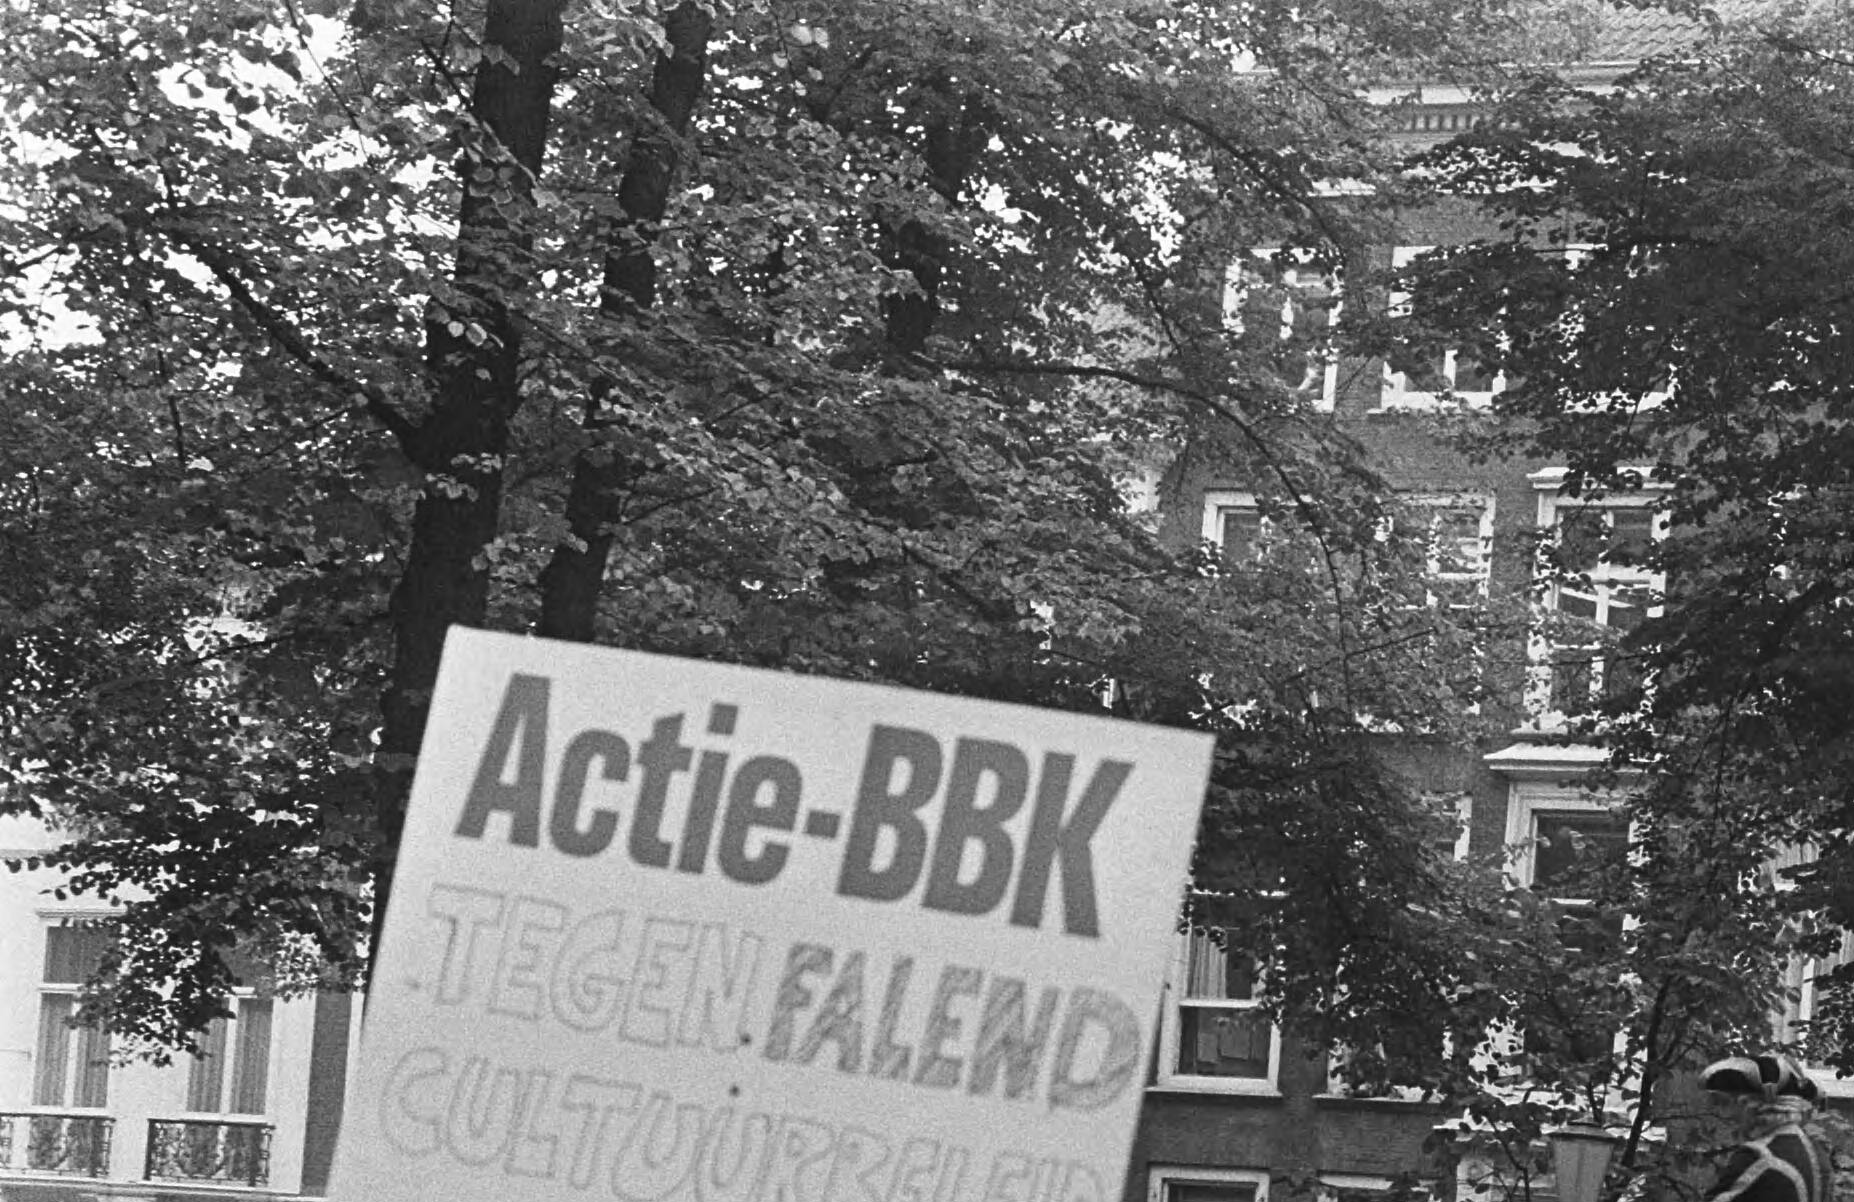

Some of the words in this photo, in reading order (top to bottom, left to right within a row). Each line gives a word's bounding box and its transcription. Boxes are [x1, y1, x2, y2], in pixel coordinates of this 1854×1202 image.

[454, 674, 1135, 938] Actie-BBK
[427, 882, 763, 1050] TEGEN
[760, 942, 1140, 1111] FALEND
